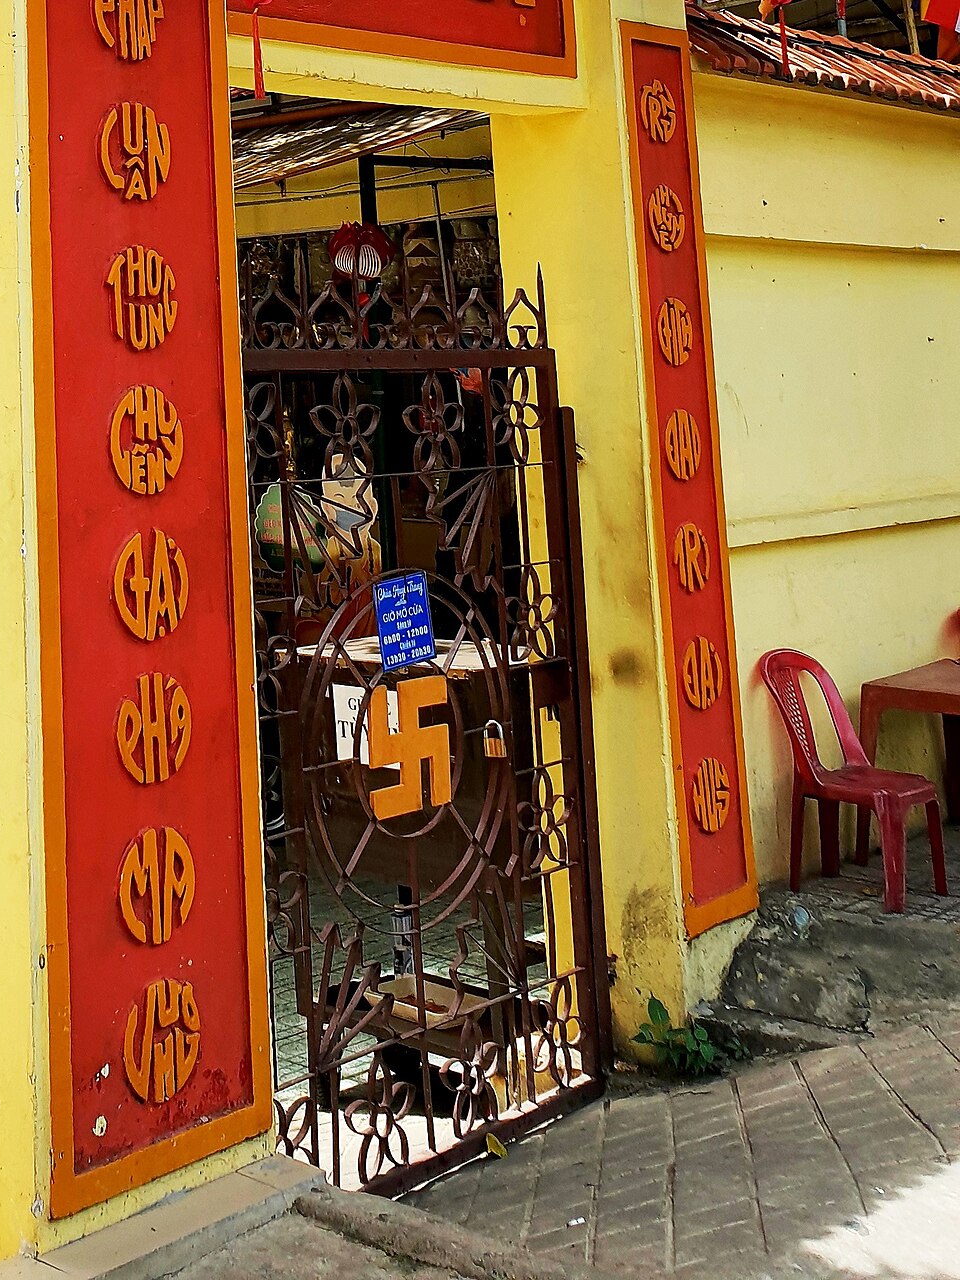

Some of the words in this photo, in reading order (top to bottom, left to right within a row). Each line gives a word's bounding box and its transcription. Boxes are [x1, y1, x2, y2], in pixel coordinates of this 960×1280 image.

[113, 528, 189, 641] ĐẠI
[117, 671, 192, 785] PHÁ
[119, 827, 196, 945] MA
